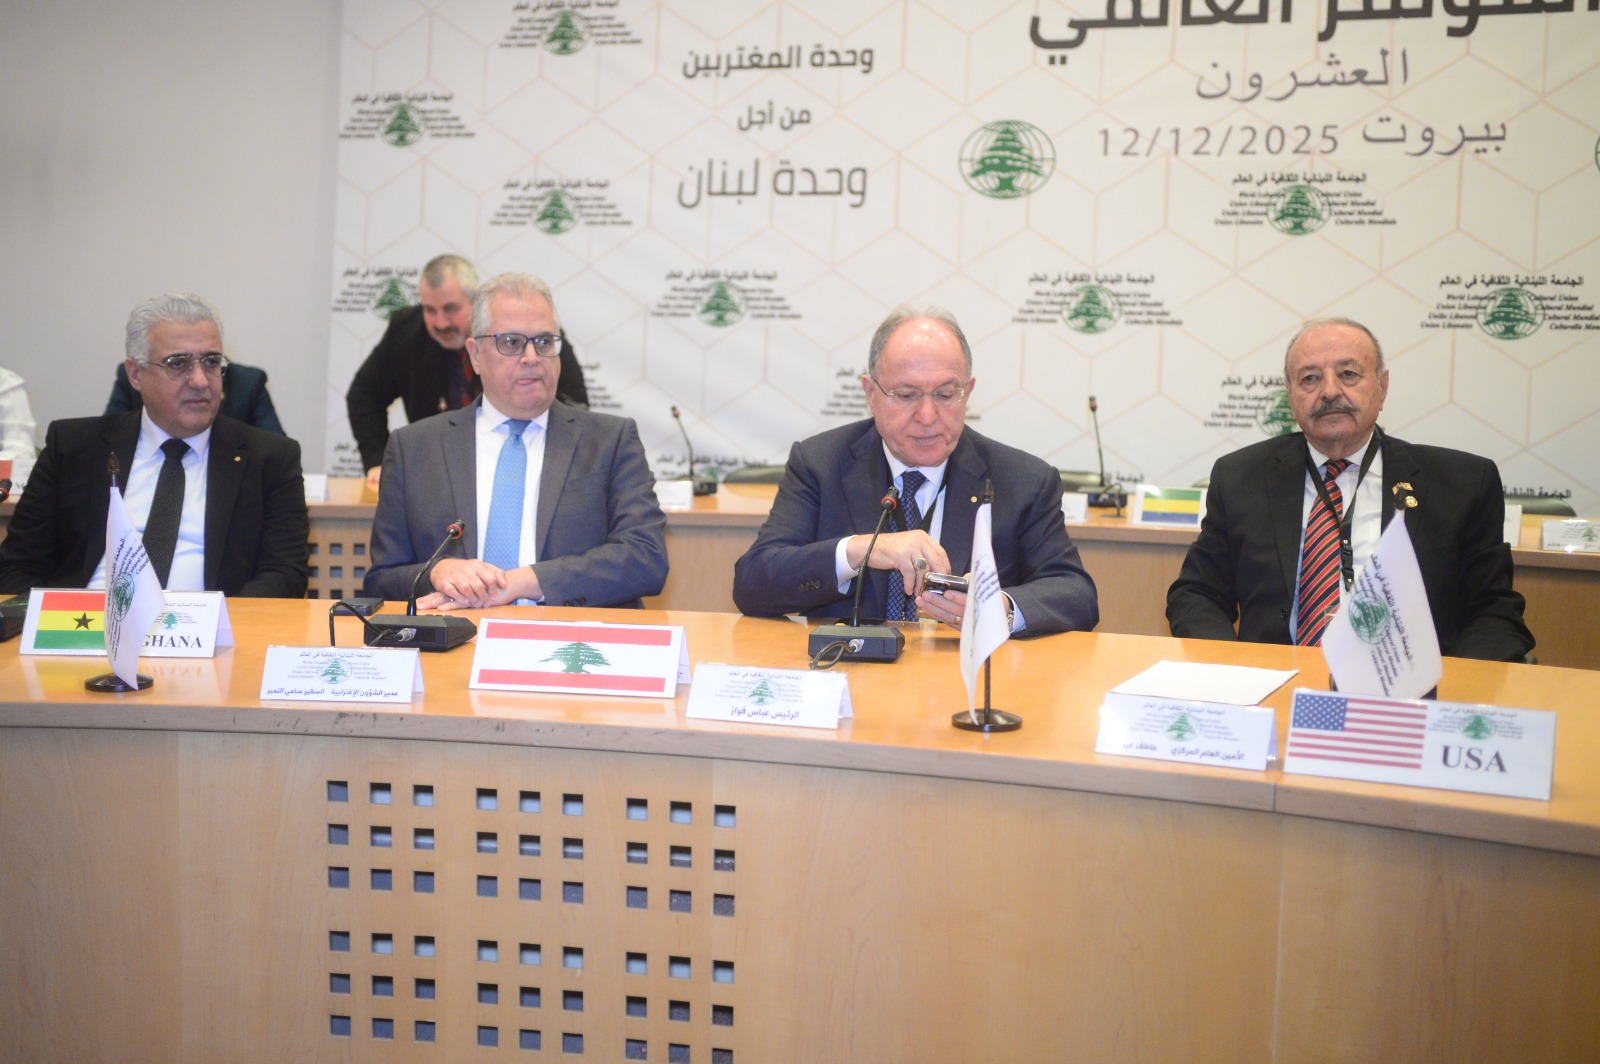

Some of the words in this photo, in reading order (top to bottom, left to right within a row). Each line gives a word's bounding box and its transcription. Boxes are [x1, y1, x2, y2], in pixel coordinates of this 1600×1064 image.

[682, 45, 802, 78] المغتربين
[810, 44, 874, 77] وحدة
[1196, 47, 1409, 103] العشرون
[738, 100, 774, 131] أجل
[779, 107, 811, 131] من
[1098, 124, 1339, 157] 12/12/2025
[1362, 112, 1508, 156] بيروت
[678, 158, 760, 210] لبنان
[773, 160, 868, 209] وحدة
[1465, 274, 1477, 288] في
[747, 708, 769, 718] عباس
[771, 710, 800, 721] الرئيس
[1442, 744, 1508, 774] USA
